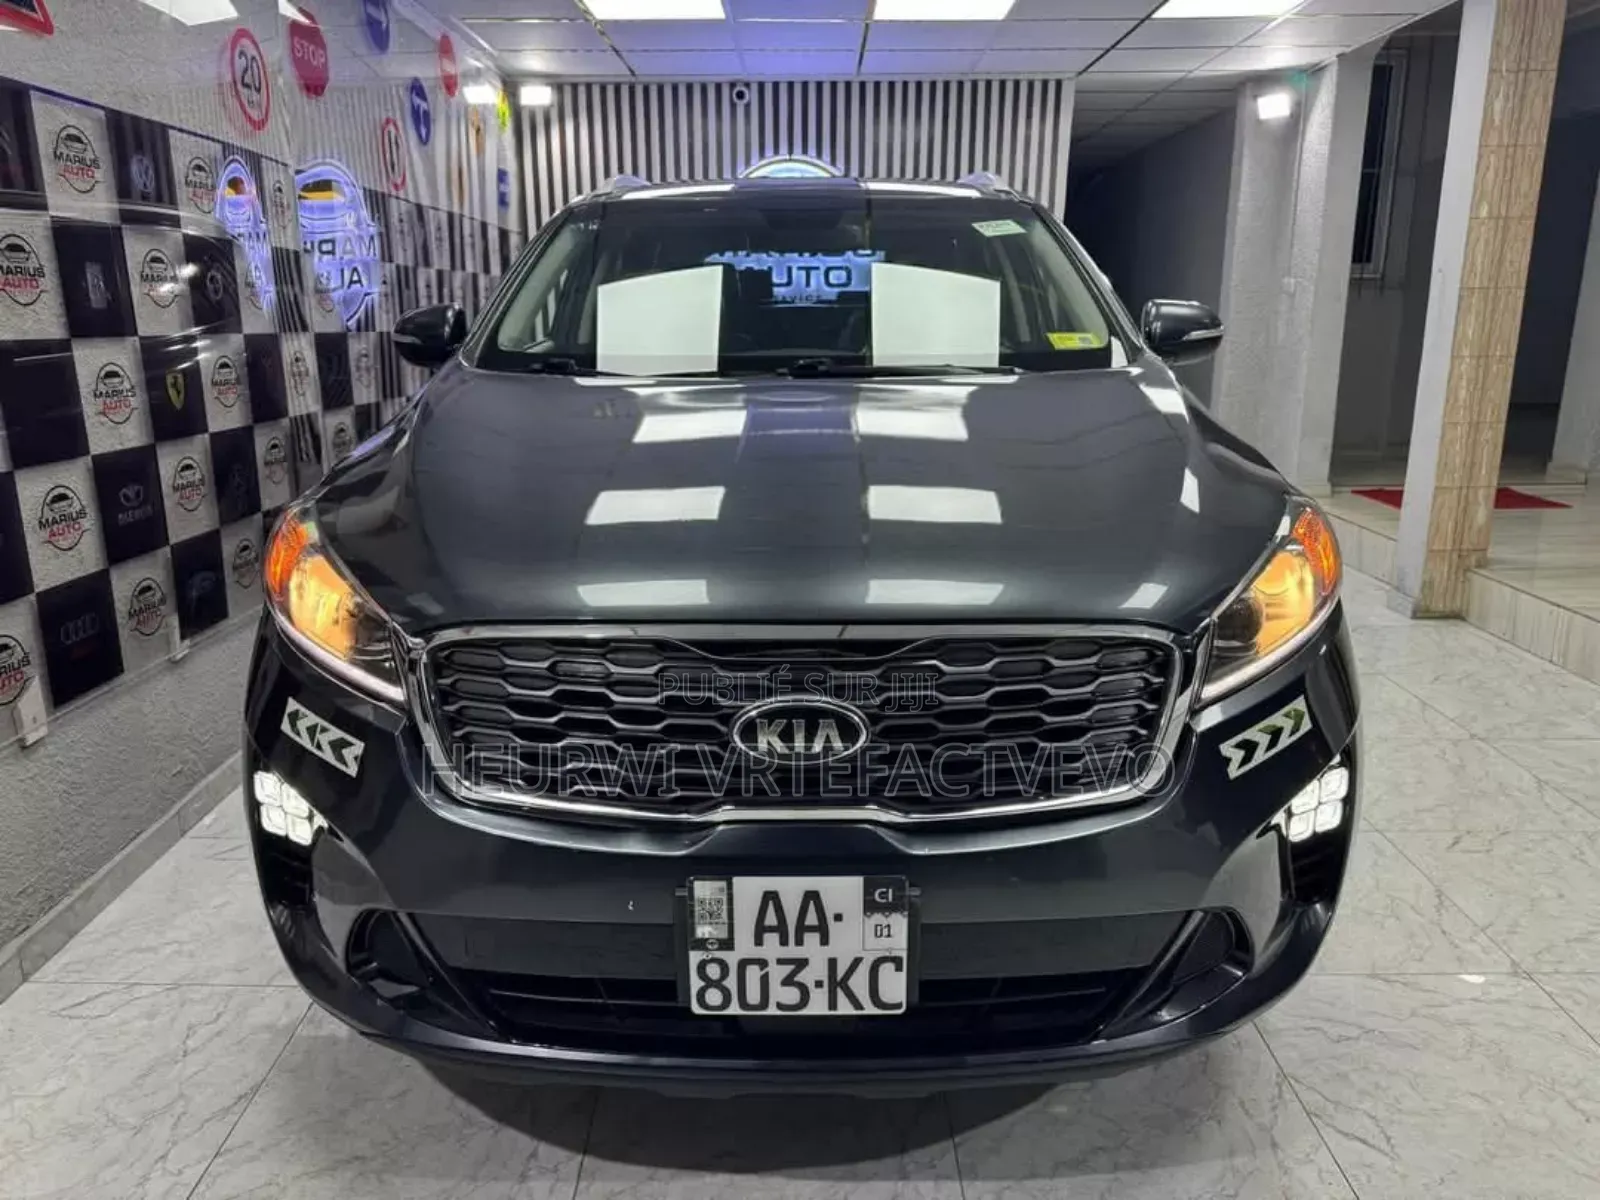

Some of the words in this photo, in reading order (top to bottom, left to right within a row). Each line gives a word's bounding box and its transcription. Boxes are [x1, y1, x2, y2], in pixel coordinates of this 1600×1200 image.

[293, 36, 326, 69] STOP
[238, 49, 261, 94] 20
[53, 149, 101, 170] MARIUS
[3, 277, 40, 289] AUTO
[769, 265, 852, 289] UTO
[38, 509, 88, 531] MARIUS
[48, 521, 82, 540] AUTO
[756, 719, 845, 754] KIA
[873, 887, 893, 903] CI
[873, 923, 892, 939] 01
